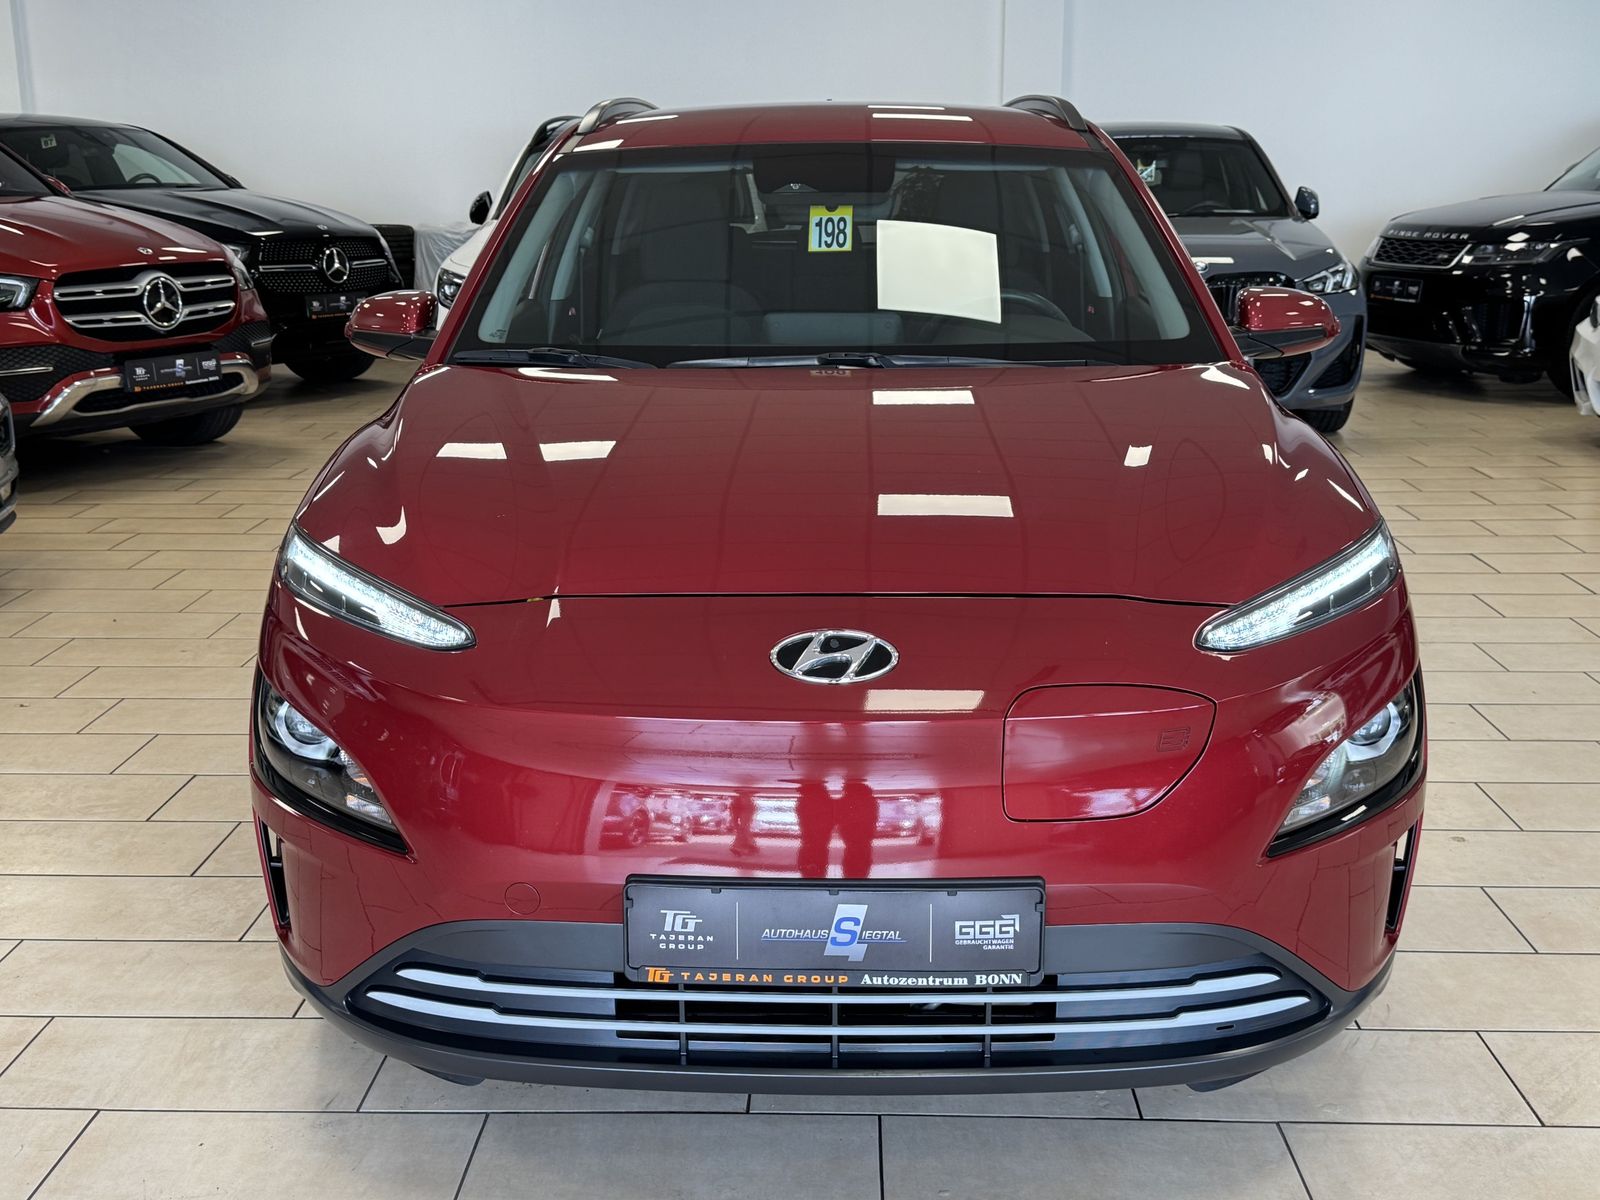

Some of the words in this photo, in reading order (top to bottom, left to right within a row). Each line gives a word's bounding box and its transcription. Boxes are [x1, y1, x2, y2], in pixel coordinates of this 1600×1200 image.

[815, 216, 847, 248] 198
[1424, 231, 1470, 240] ROVER
[660, 909, 703, 932] TG
[760, 928, 829, 939] AUTOHAUS
[954, 919, 1014, 939] GGG
[649, 933, 714, 942] TAJERAN
[954, 938, 1015, 946] GEBRAUCHTWAGEN
[659, 942, 705, 950] GROUP
[645, 967, 674, 983] TG
[680, 972, 773, 983] TAJERAN
[783, 974, 849, 983] GROUP
[861, 973, 969, 986] Autozentrum
[974, 973, 1023, 985] BONN
